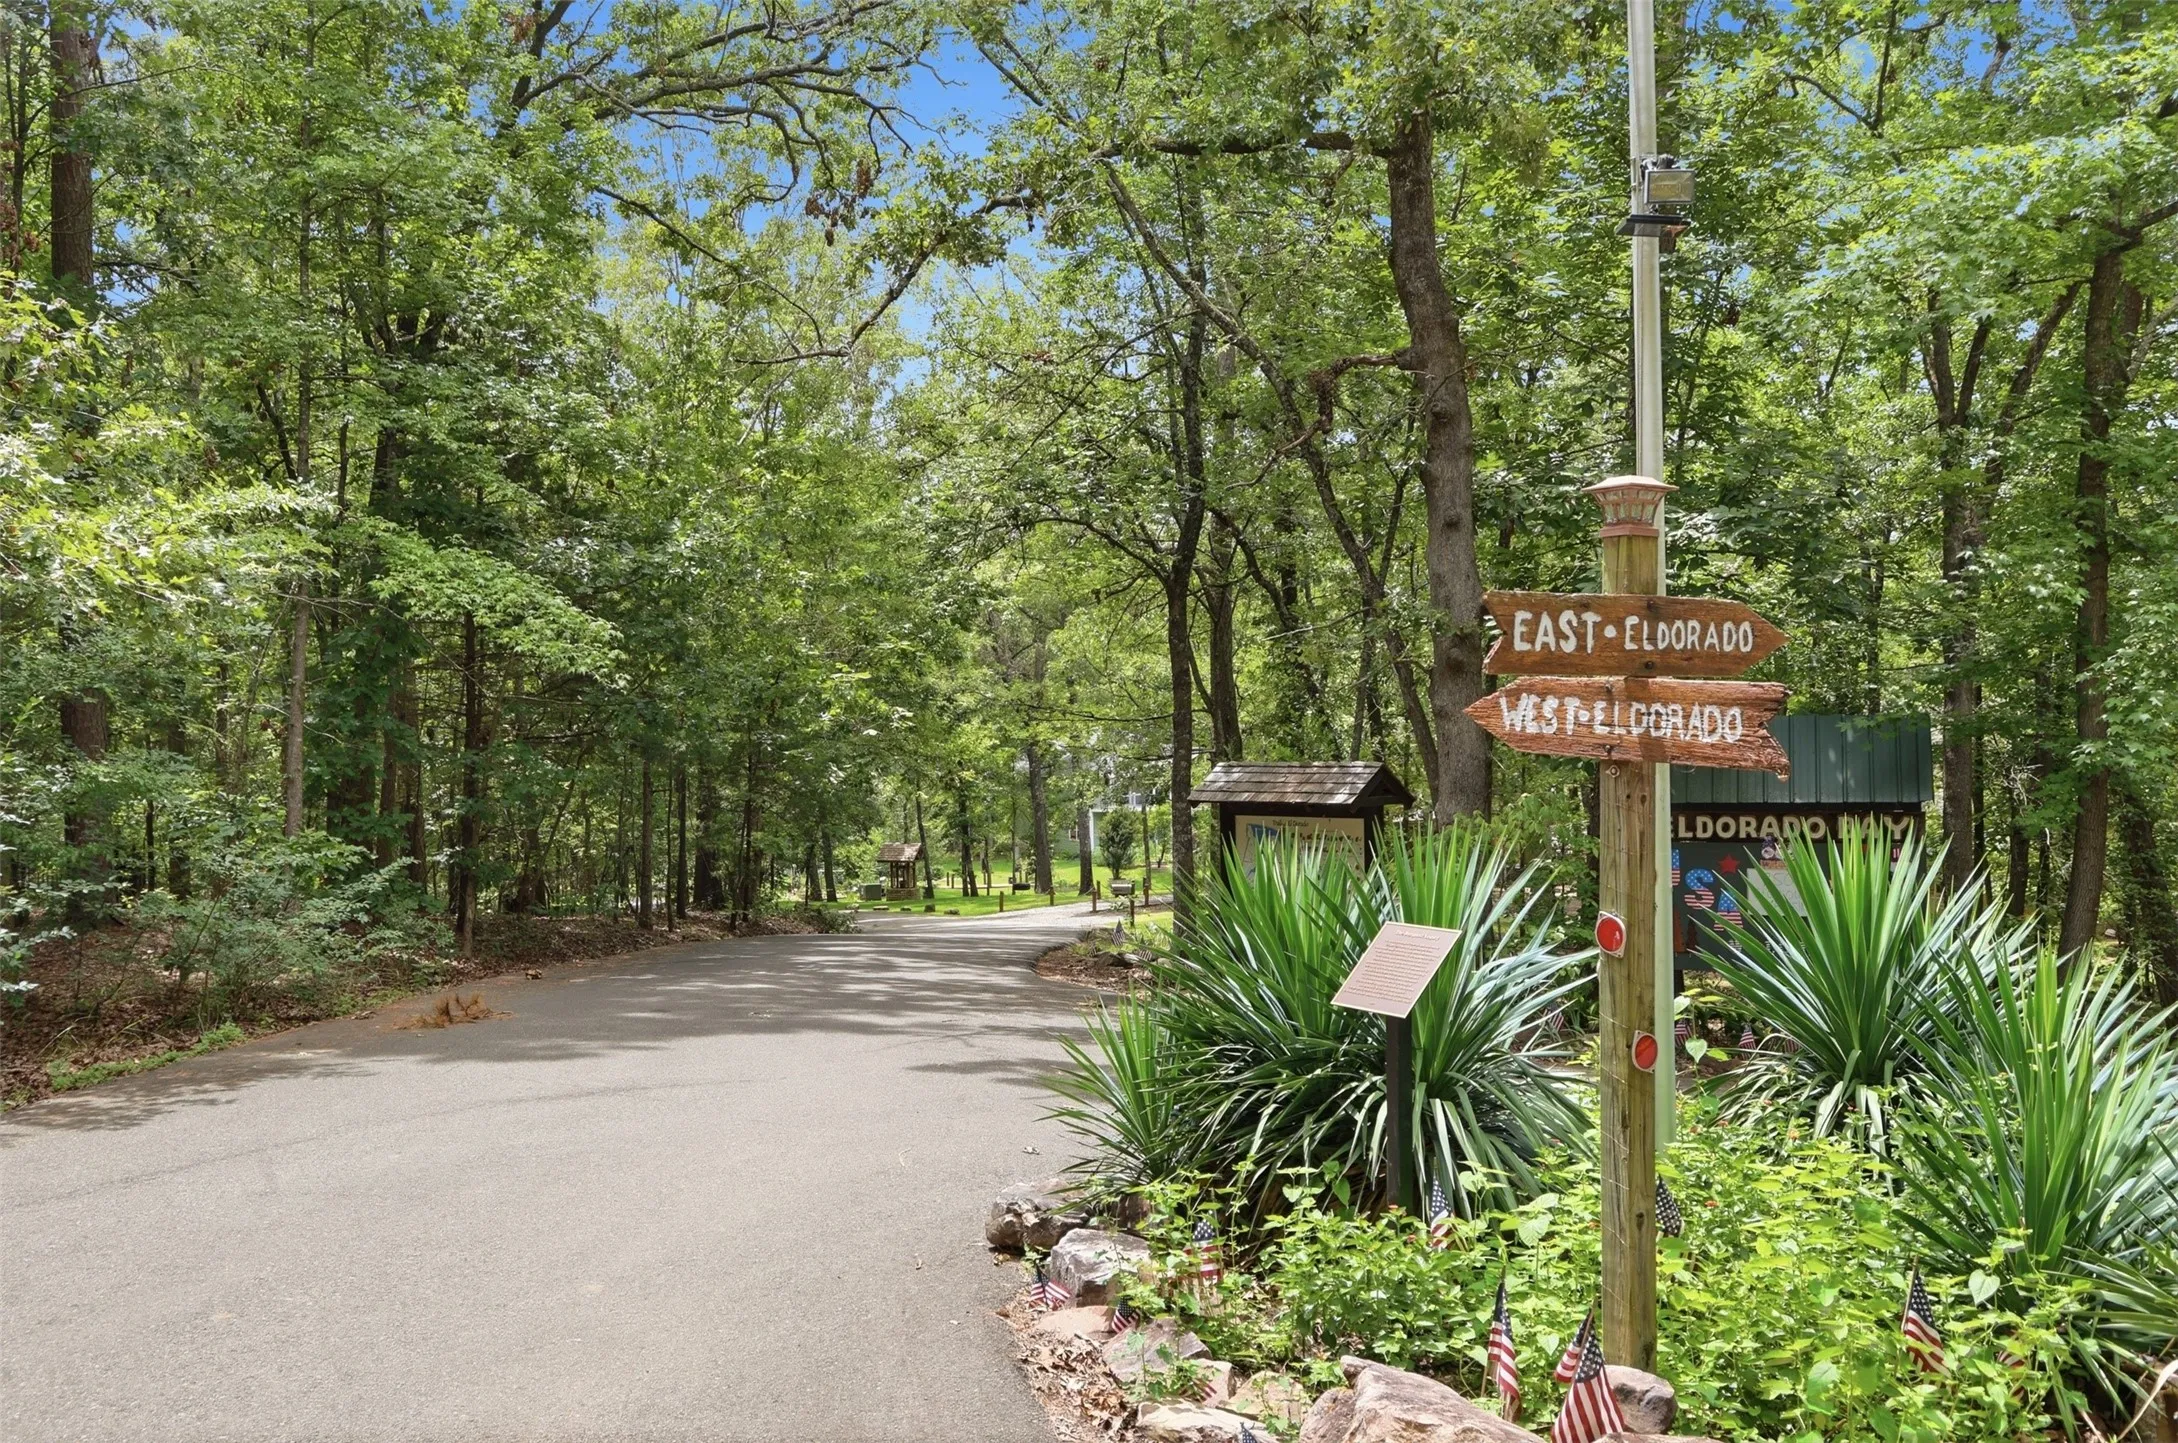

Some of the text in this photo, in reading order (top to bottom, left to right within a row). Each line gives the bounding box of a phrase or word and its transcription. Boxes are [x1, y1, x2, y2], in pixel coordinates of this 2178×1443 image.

[1513, 609, 1754, 654] EAST ELDORADO
[1499, 692, 1744, 743] WEST ELDORADO
[1671, 815, 1826, 839] LDORADO
